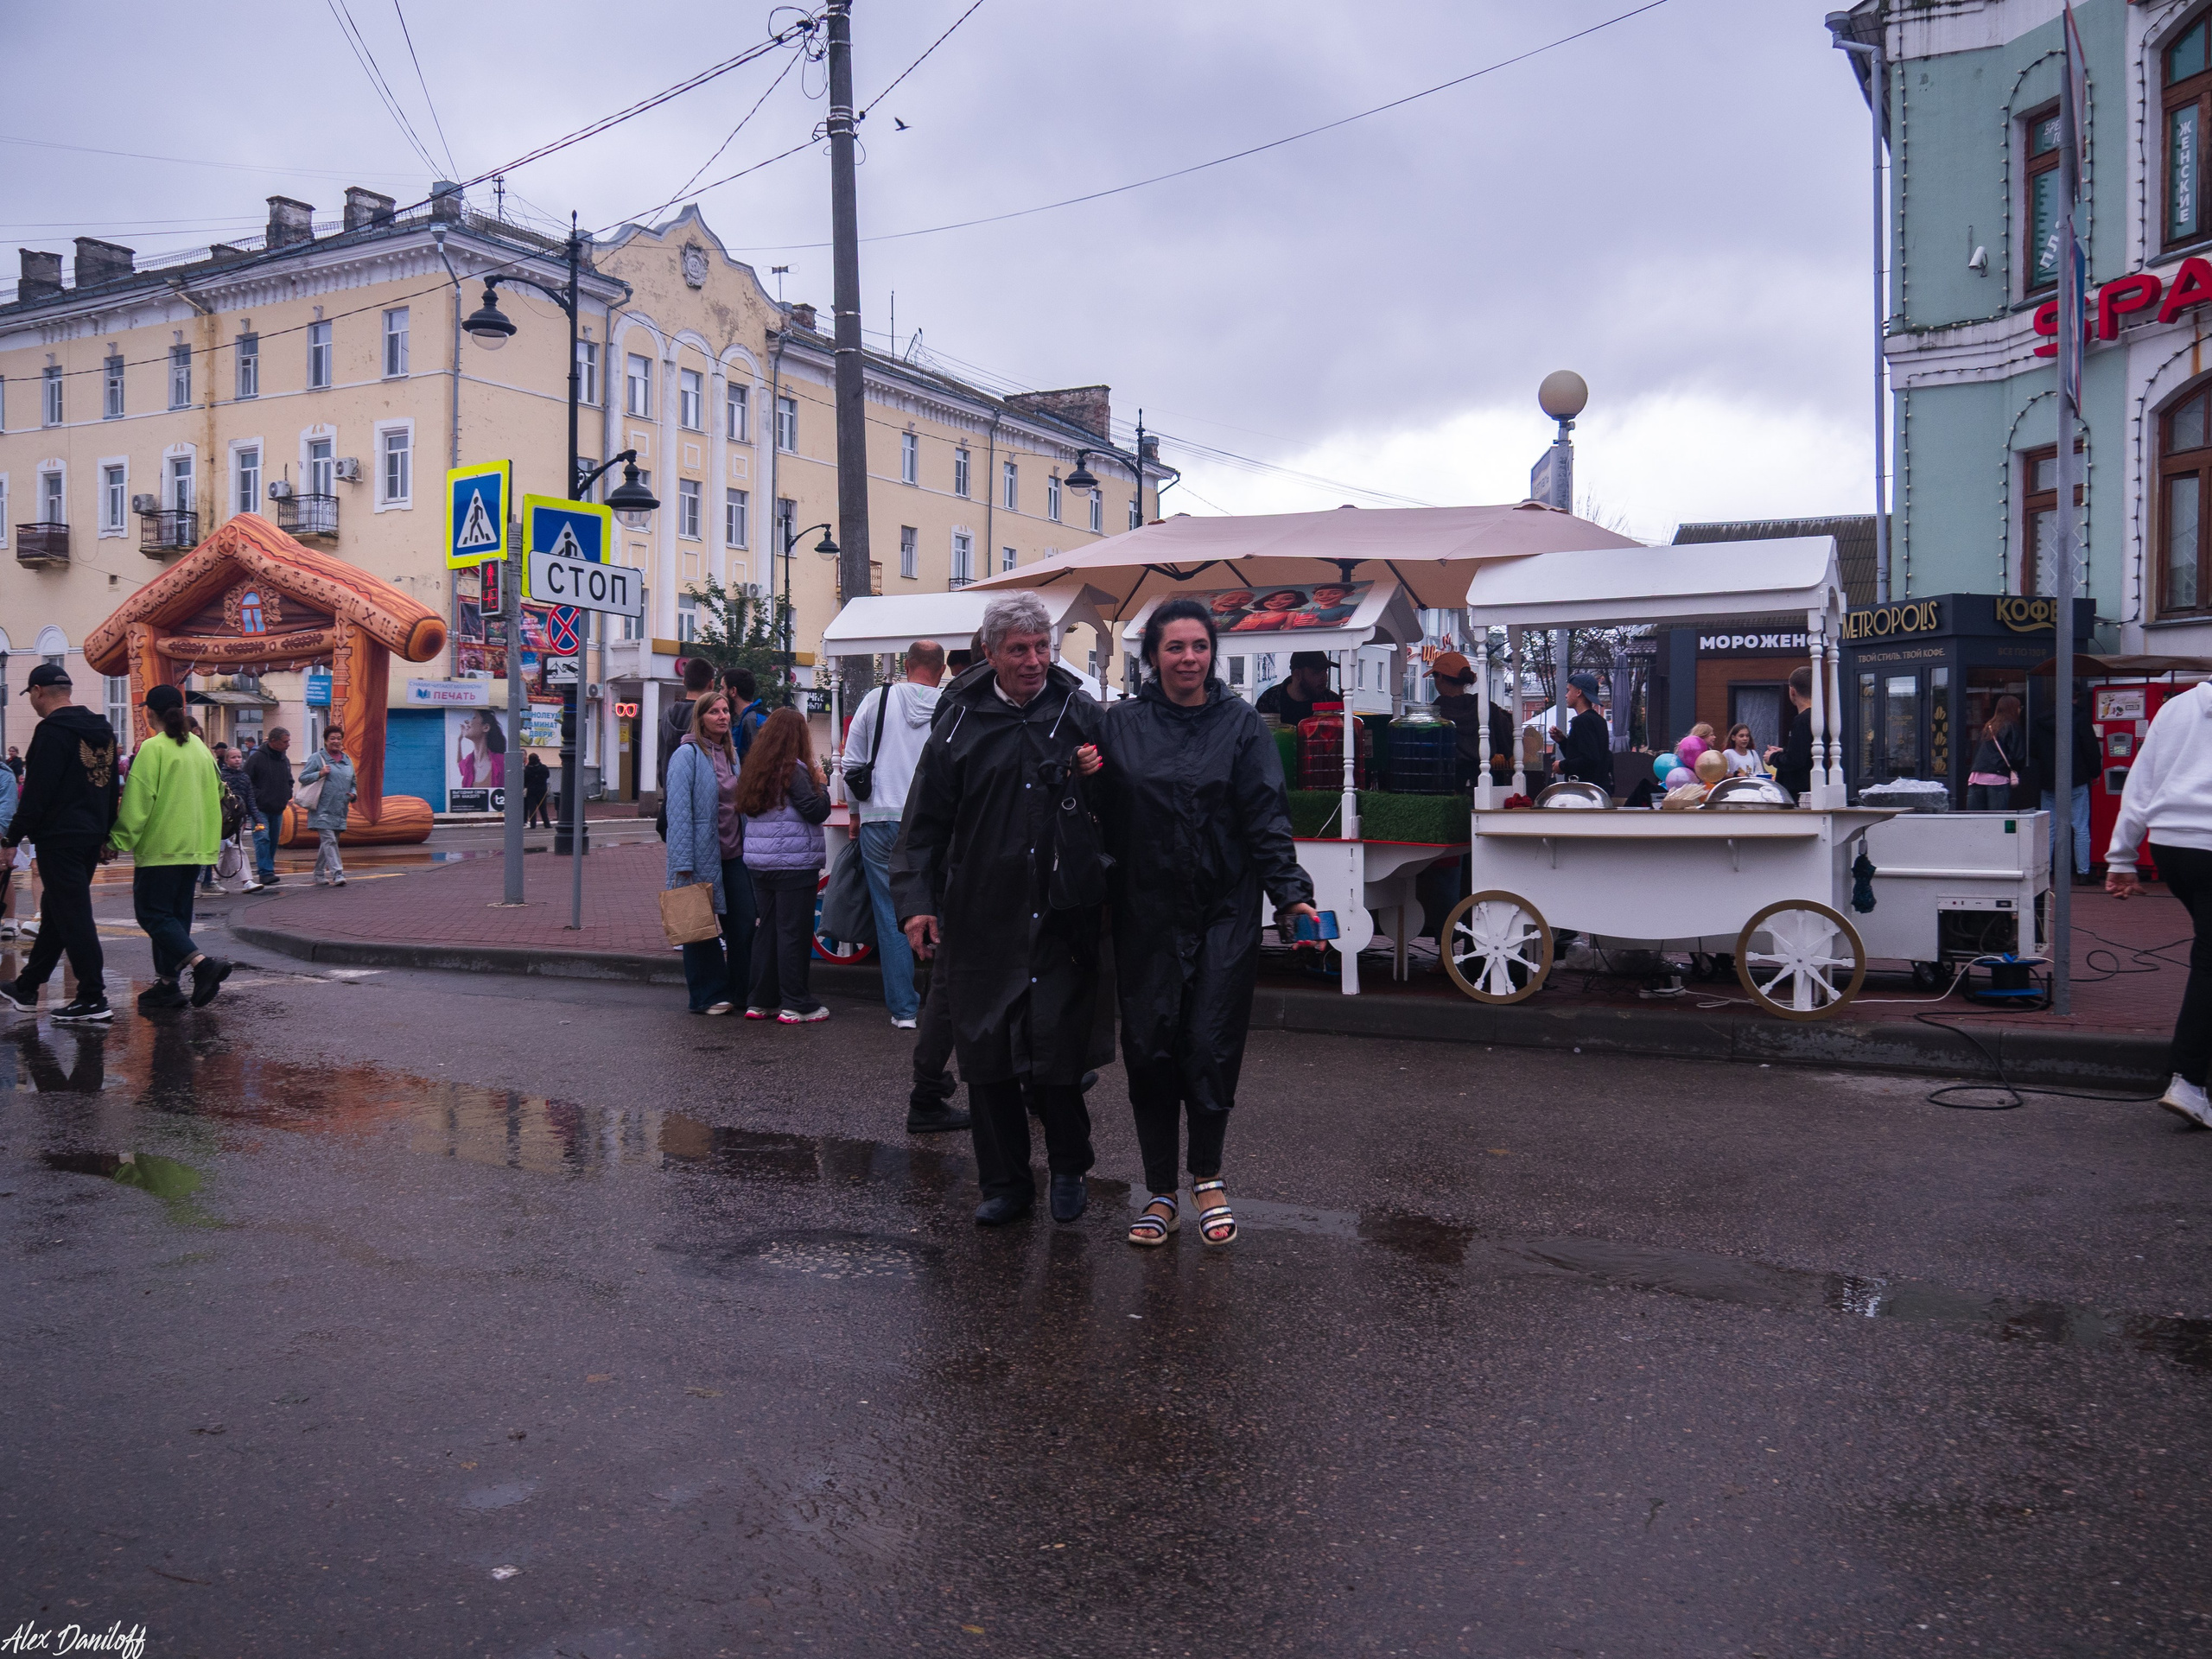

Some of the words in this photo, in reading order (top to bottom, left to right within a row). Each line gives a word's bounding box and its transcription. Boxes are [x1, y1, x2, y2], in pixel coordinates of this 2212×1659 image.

[2179, 120, 2192, 223] ЖЕНСКИЕ
[547, 562, 626, 606] СТОП
[1842, 601, 1938, 640] METROPOLIS
[1858, 652, 1877, 663] ТВОЙ
[1877, 652, 1902, 662] СТИЛЬ.
[1902, 648, 1922, 659] ТВОЙ
[1923, 647, 1946, 658] КОФЕ.
[433, 691, 476, 700] ПЕЧАТЬ
[520, 710, 562, 719] ЛИНОЛЕУМ
[523, 720, 558, 728] ЛАМИНАТ
